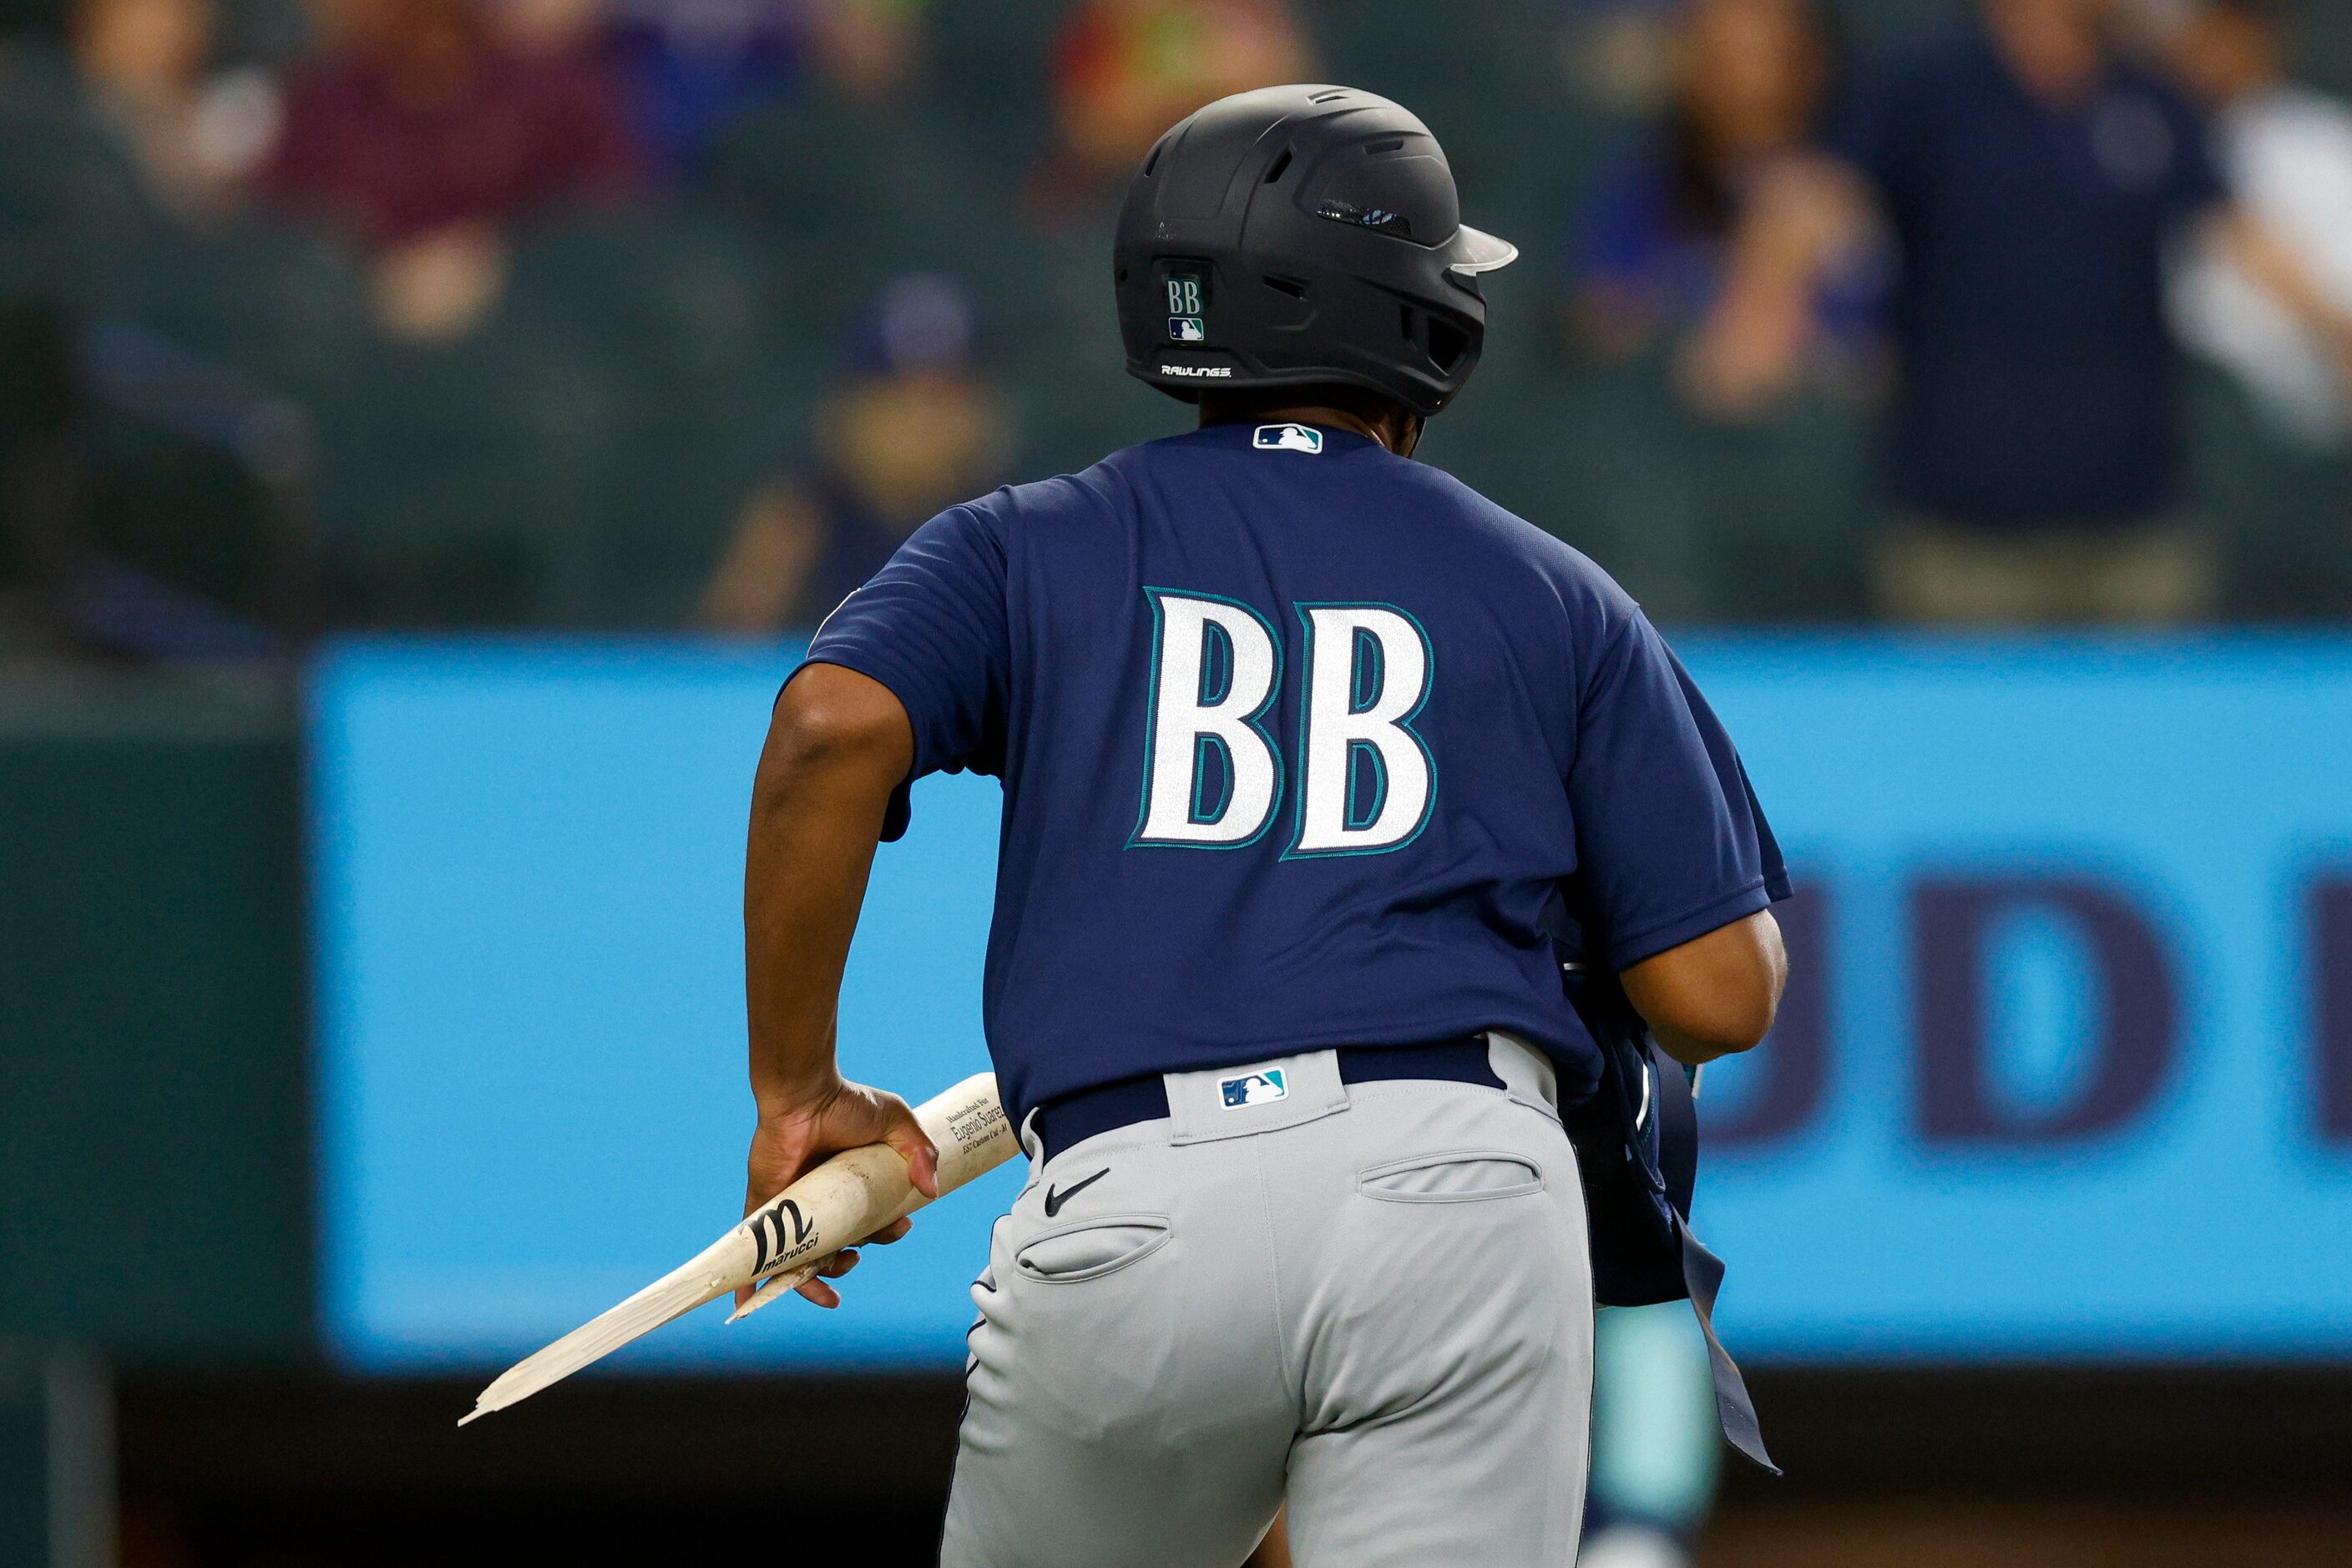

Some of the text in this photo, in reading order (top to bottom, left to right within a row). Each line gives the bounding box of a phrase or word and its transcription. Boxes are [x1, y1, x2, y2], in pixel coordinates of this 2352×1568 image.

[1167, 280, 1201, 315] BB
[1124, 585, 1439, 863] BB
[946, 1101, 980, 1123] Handcrafted
[950, 1105, 1005, 1141] Eugenio Suarez
[989, 1129, 999, 1139] Cut
[761, 1232, 819, 1274] marucci
